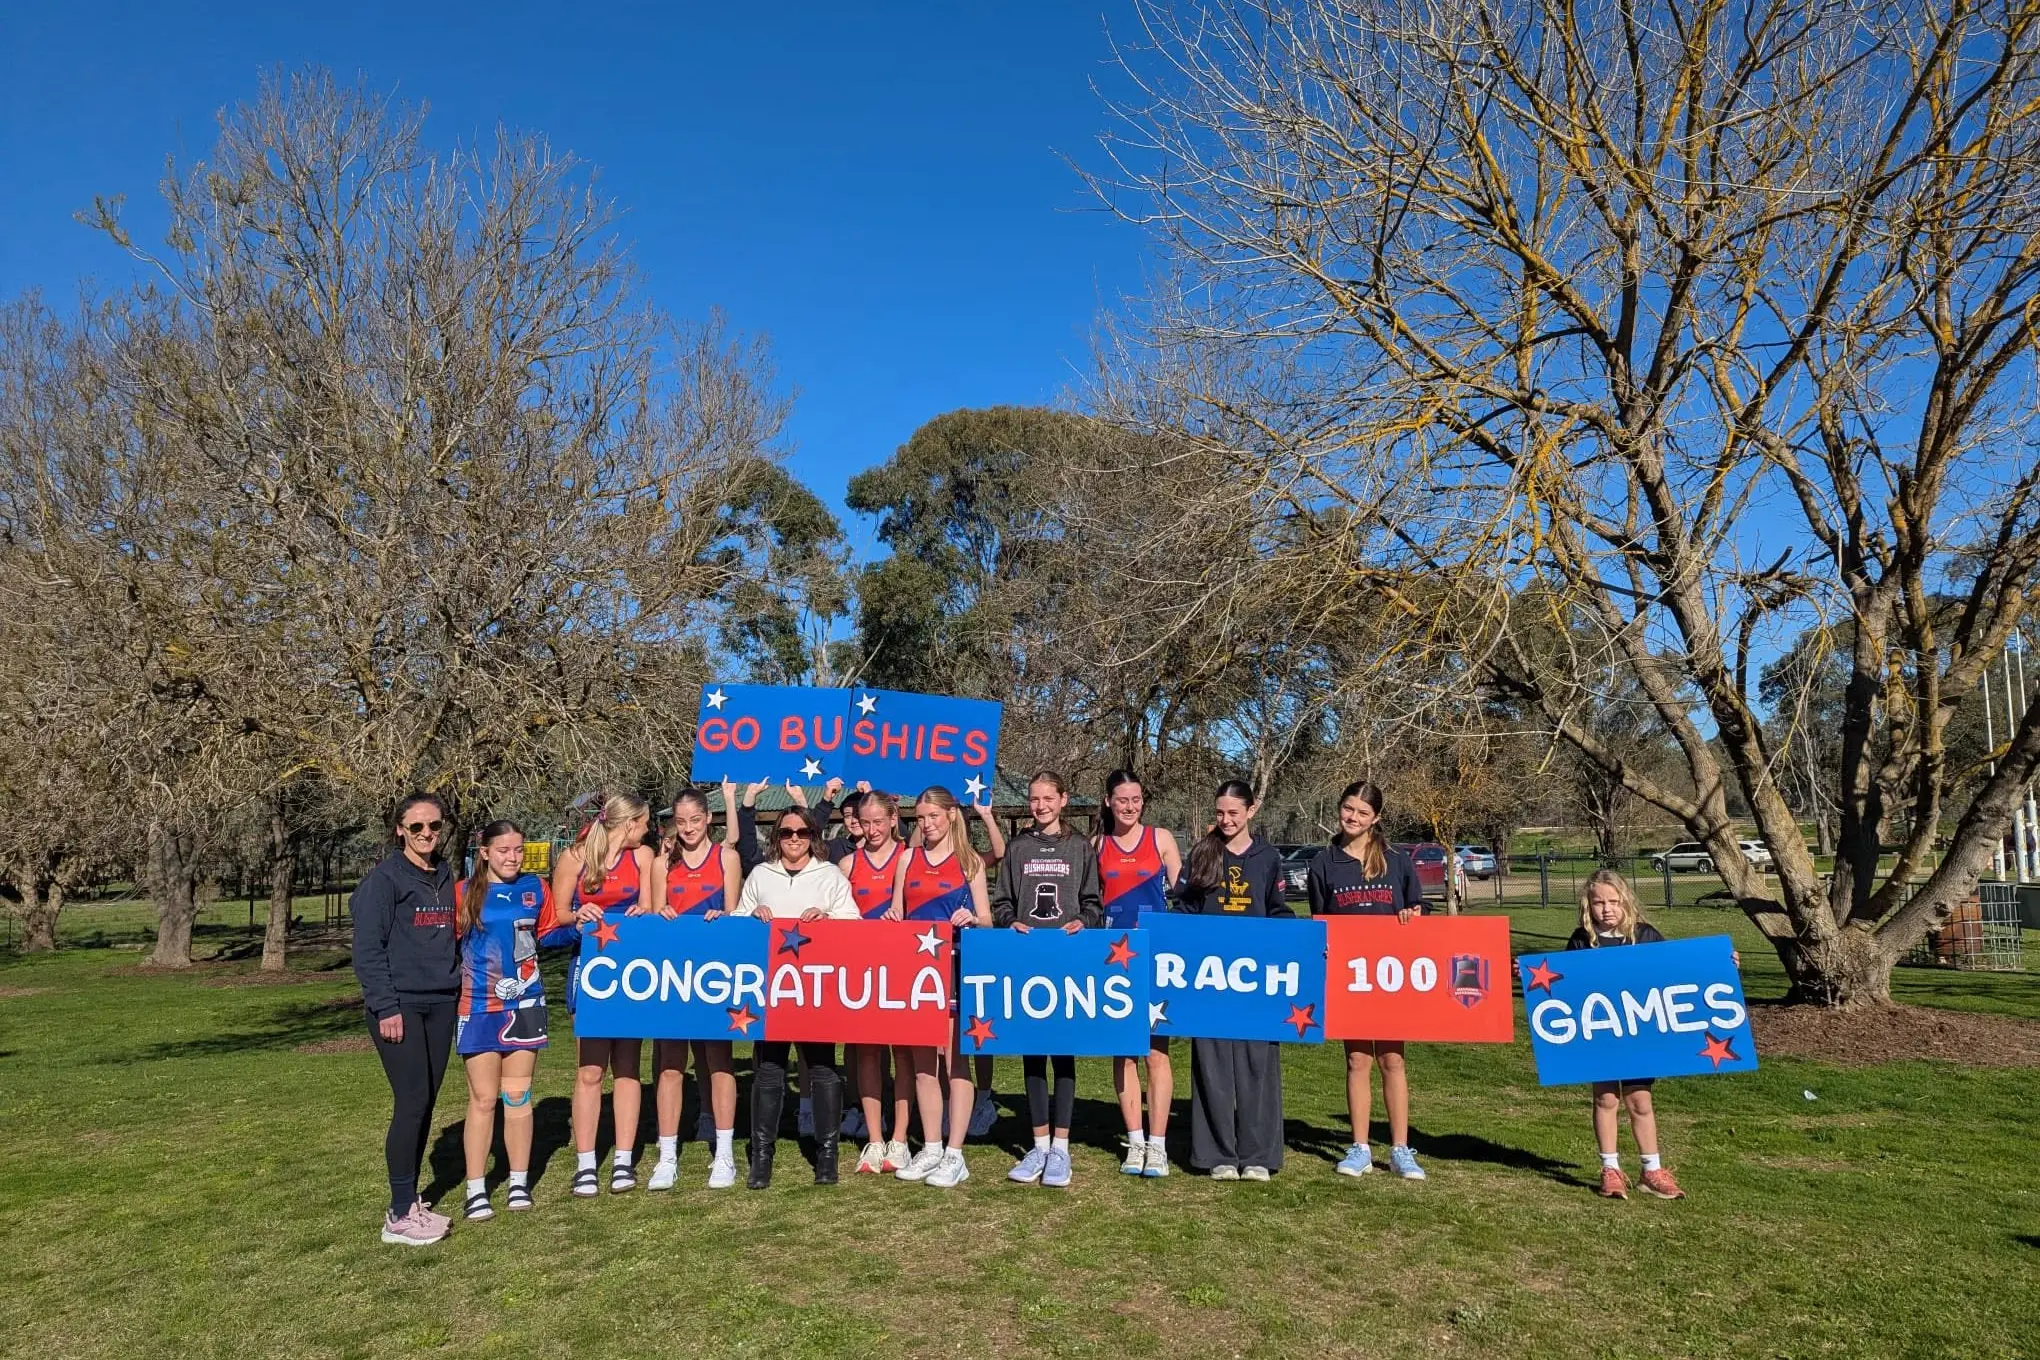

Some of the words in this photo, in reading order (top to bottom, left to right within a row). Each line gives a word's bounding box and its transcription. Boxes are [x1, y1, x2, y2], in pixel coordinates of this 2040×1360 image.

[698, 716, 761, 753] GO
[779, 715, 989, 766] BUSHIES
[1023, 862, 1070, 876] BUSHRANGERS
[1153, 952, 1300, 998] RACH
[1346, 955, 1439, 993] 100
[1530, 982, 1747, 1045] GAMES
